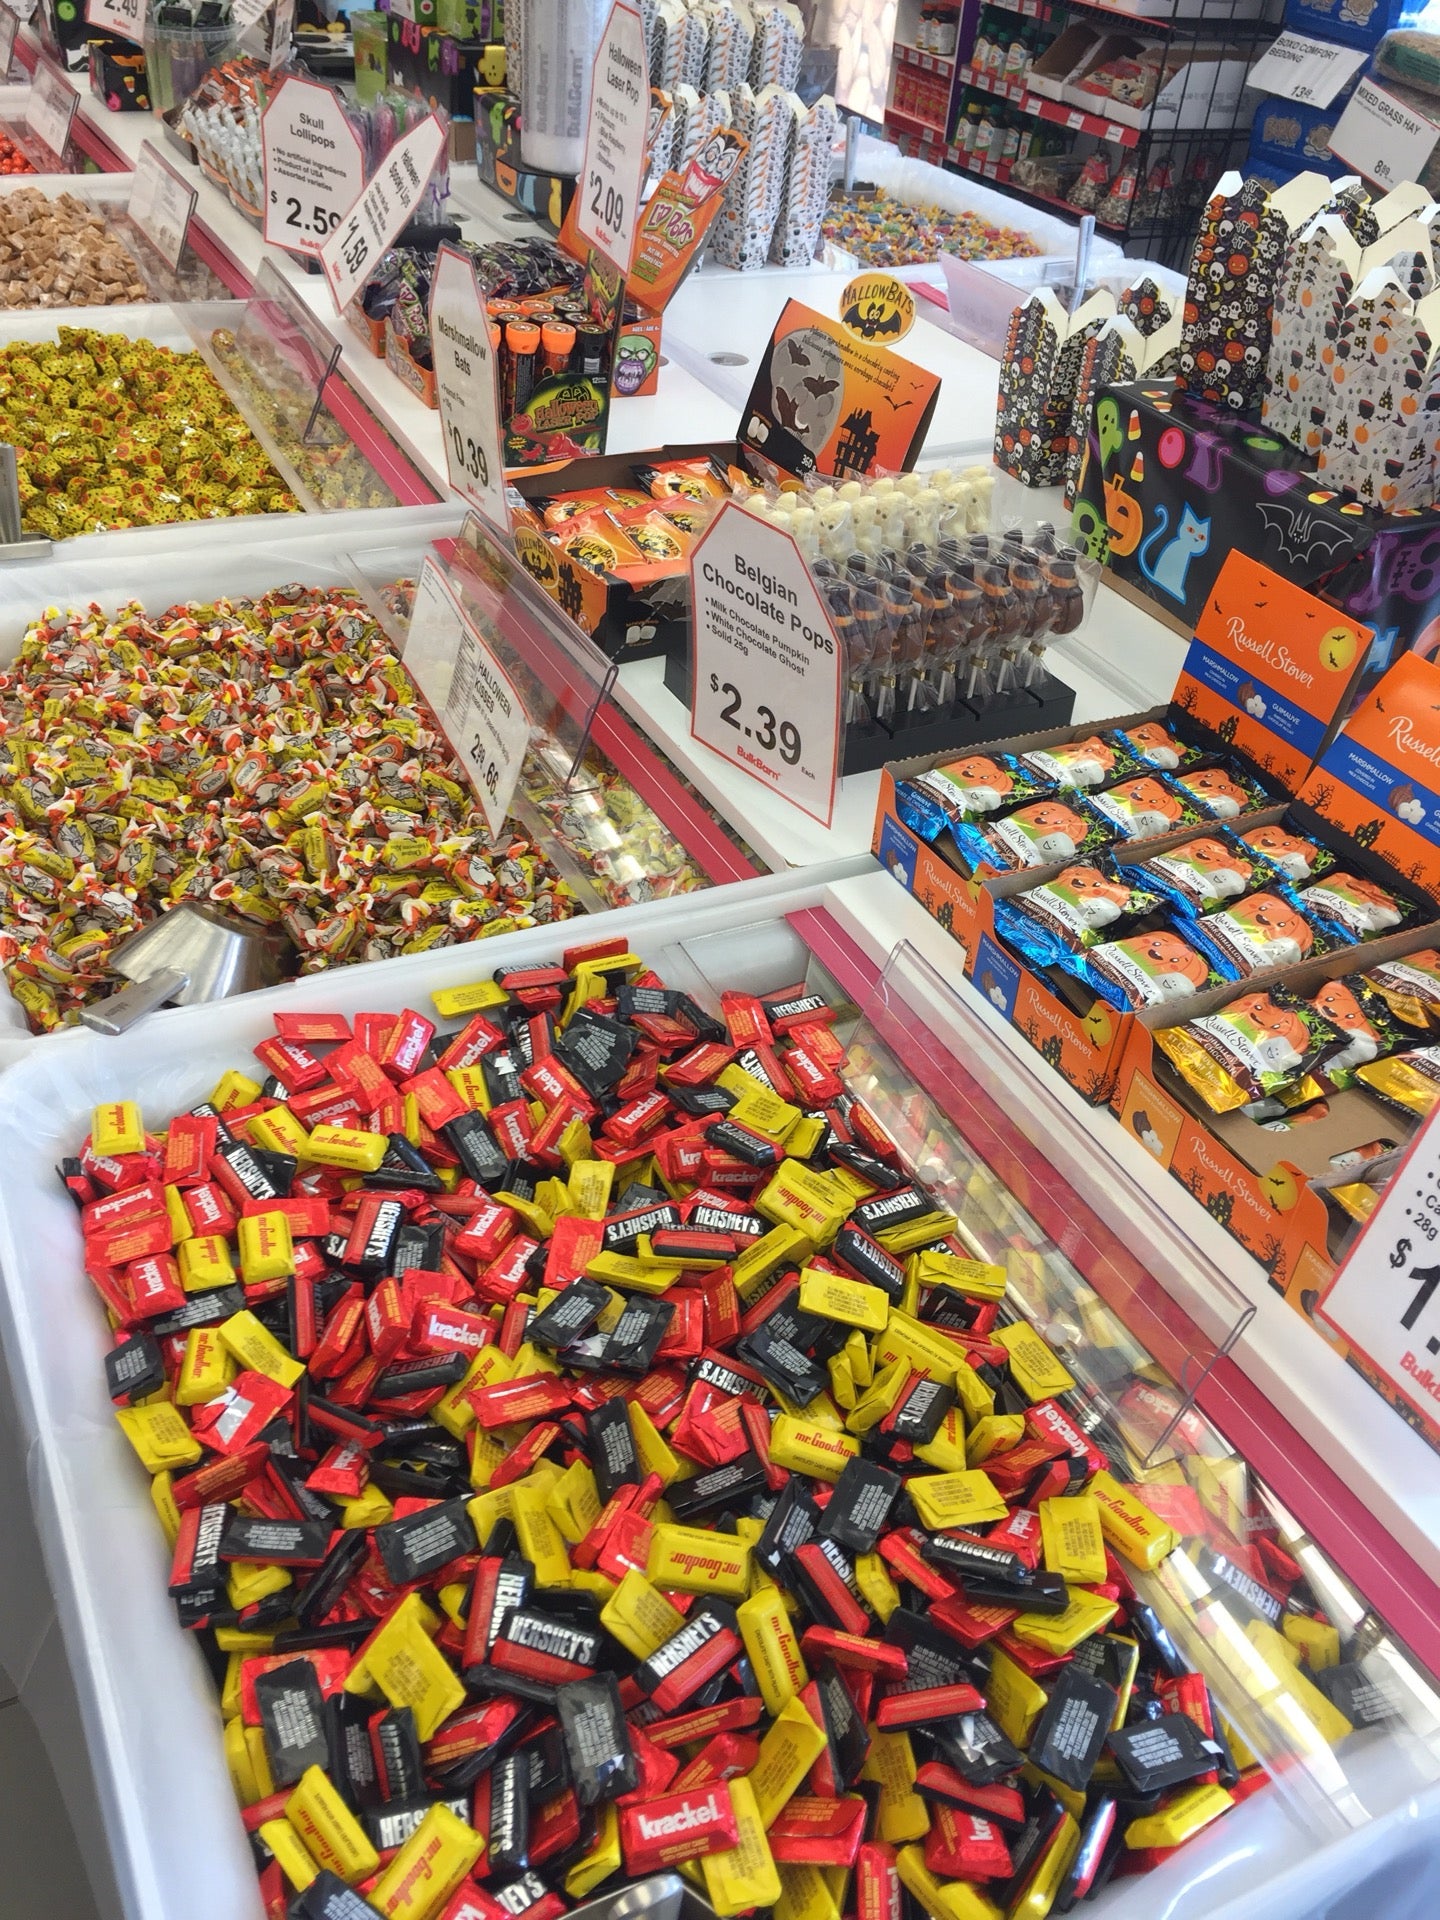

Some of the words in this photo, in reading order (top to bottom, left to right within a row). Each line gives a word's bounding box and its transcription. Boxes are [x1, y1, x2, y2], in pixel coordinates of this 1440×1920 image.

[608, 41, 642, 79] Halloween
[1267, 47, 1305, 64] BEDDING
[1276, 37, 1299, 53] BOXO
[1298, 43, 1340, 61] COMFORT
[607, 67, 626, 94] Laser
[626, 80, 640, 106] Pop
[299, 112, 324, 131] Skull
[1357, 86, 1378, 107] MIXED
[1377, 100, 1404, 125] GRASS
[1404, 119, 1421, 136] HAY
[290, 124, 336, 149] Lollipops
[276, 147, 286, 157] No
[312, 159, 347, 177] ingredients
[438, 315, 487, 361] Marshmallow
[454, 350, 472, 377] Bats
[883, 363, 901, 384] coating
[534, 400, 598, 421] Halloween
[536, 415, 572, 431] LASER
[577, 411, 598, 424] POP
[447, 419, 489, 488] $0.39
[801, 453, 812, 468] 360
[734, 553, 798, 607] Belgian
[702, 562, 785, 625] Chocolate
[790, 613, 834, 655] Pops
[710, 597, 728, 614] Milk
[729, 604, 770, 641] Chocolate
[772, 632, 810, 666] Pumpkin
[711, 624, 732, 646] Solid
[733, 638, 749, 658] 25g
[711, 611, 735, 633] White
[735, 624, 777, 662] Chocolate
[778, 651, 806, 677] Ghost
[1226, 616, 1275, 671] Russell
[1270, 646, 1315, 689] Stover
[475, 677, 494, 714] KISSES
[478, 660, 512, 719] HALLOWEEN
[1202, 655, 1240, 684] MARSHMALLOW
[1272, 702, 1301, 726] GUIMAUVE
[710, 672, 802, 767] $2.39
[1387, 716, 1440, 769] Russell
[736, 745, 780, 782] BulkBarn
[801, 765, 816, 780] Each
[1348, 752, 1394, 785] MARSHMALLOW
[910, 791, 930, 808] GUIMAUVE
[884, 819, 917, 852] MARSHMALLOW
[923, 859, 955, 899] Russell
[950, 885, 977, 919] Stover
[1030, 886, 1055, 910] Russell
[1051, 899, 1079, 927] Stover
[1304, 888, 1337, 908] Russell
[1023, 898, 1059, 928] MARSHMALLOW
[1213, 911, 1243, 943] Russell
[982, 937, 1019, 979] MARSHMALLOW
[1206, 921, 1245, 963] MARSHMALLOW
[1106, 945, 1132, 974] Russell
[1128, 964, 1156, 998] Stover
[1388, 963, 1425, 983] Russell
[772, 994, 826, 1018] HERSHEY'S
[1027, 986, 1065, 1035] Russell
[1059, 1022, 1095, 1062] Stover
[396, 1018, 427, 1070] krackel
[447, 1031, 493, 1072] krackel
[1202, 1016, 1236, 1042] Russell
[1231, 1036, 1261, 1067] Stover
[1203, 1042, 1237, 1078] CHOCOLATE
[788, 1049, 827, 1084] krackel
[1410, 1061, 1432, 1077] DARK
[303, 1098, 362, 1130] krackel
[617, 1091, 662, 1126] krackel
[263, 1118, 300, 1157] mr.Goodbar
[313, 1133, 368, 1151] mr.Goodbar
[715, 1121, 773, 1151] HERSHEY'S
[85, 1149, 125, 1184] krackel
[226, 1148, 276, 1200] HERSHEY'S
[711, 1169, 762, 1184] krackel
[1190, 1135, 1235, 1188] Russell
[1232, 1177, 1273, 1224] Stover
[93, 1188, 154, 1220] krackel
[191, 1186, 221, 1224] krackel
[689, 1190, 731, 1210] krackel
[777, 1186, 828, 1225] mr.Goodbar
[861, 1190, 924, 1220] HERSHEY'S
[257, 1216, 271, 1259] mr.Goodbar
[364, 1200, 402, 1259] HERSHEY'S
[467, 1205, 502, 1239] krackel
[608, 1207, 673, 1242] HERSHEY'S
[695, 1206, 762, 1235] HERSHEY'S
[1413, 1212, 1439, 1241] 28g
[135, 1260, 165, 1297] krackel
[500, 1242, 539, 1284] krackel
[852, 1233, 905, 1286] HERSHEY'S
[368, 1291, 385, 1342] krackel
[429, 1314, 487, 1349] krackel
[194, 1331, 210, 1379] mr.Goodbar
[451, 1357, 495, 1411] mr.Goodbar
[899, 1380, 942, 1424] HERSHEY'S
[794, 1431, 857, 1458] mr.Goodbar
[1036, 1403, 1090, 1458] krackel
[1005, 1509, 1039, 1540] krackel
[1094, 1488, 1151, 1539] mr.Goodbar
[194, 1502, 227, 1566] HERSHEY'S
[933, 1536, 1014, 1565] HERSHEY'S
[670, 1553, 742, 1581] mr.Goodbar
[507, 1616, 595, 1666] HERSHEY'S
[651, 1611, 722, 1678] HERSHEY'S
[770, 1616, 801, 1694] mr.Goodbar
[638, 1794, 721, 1841] krackel
[299, 1808, 346, 1878] mr.Goodbar
[383, 1836, 442, 1916] mr.Goodbar
